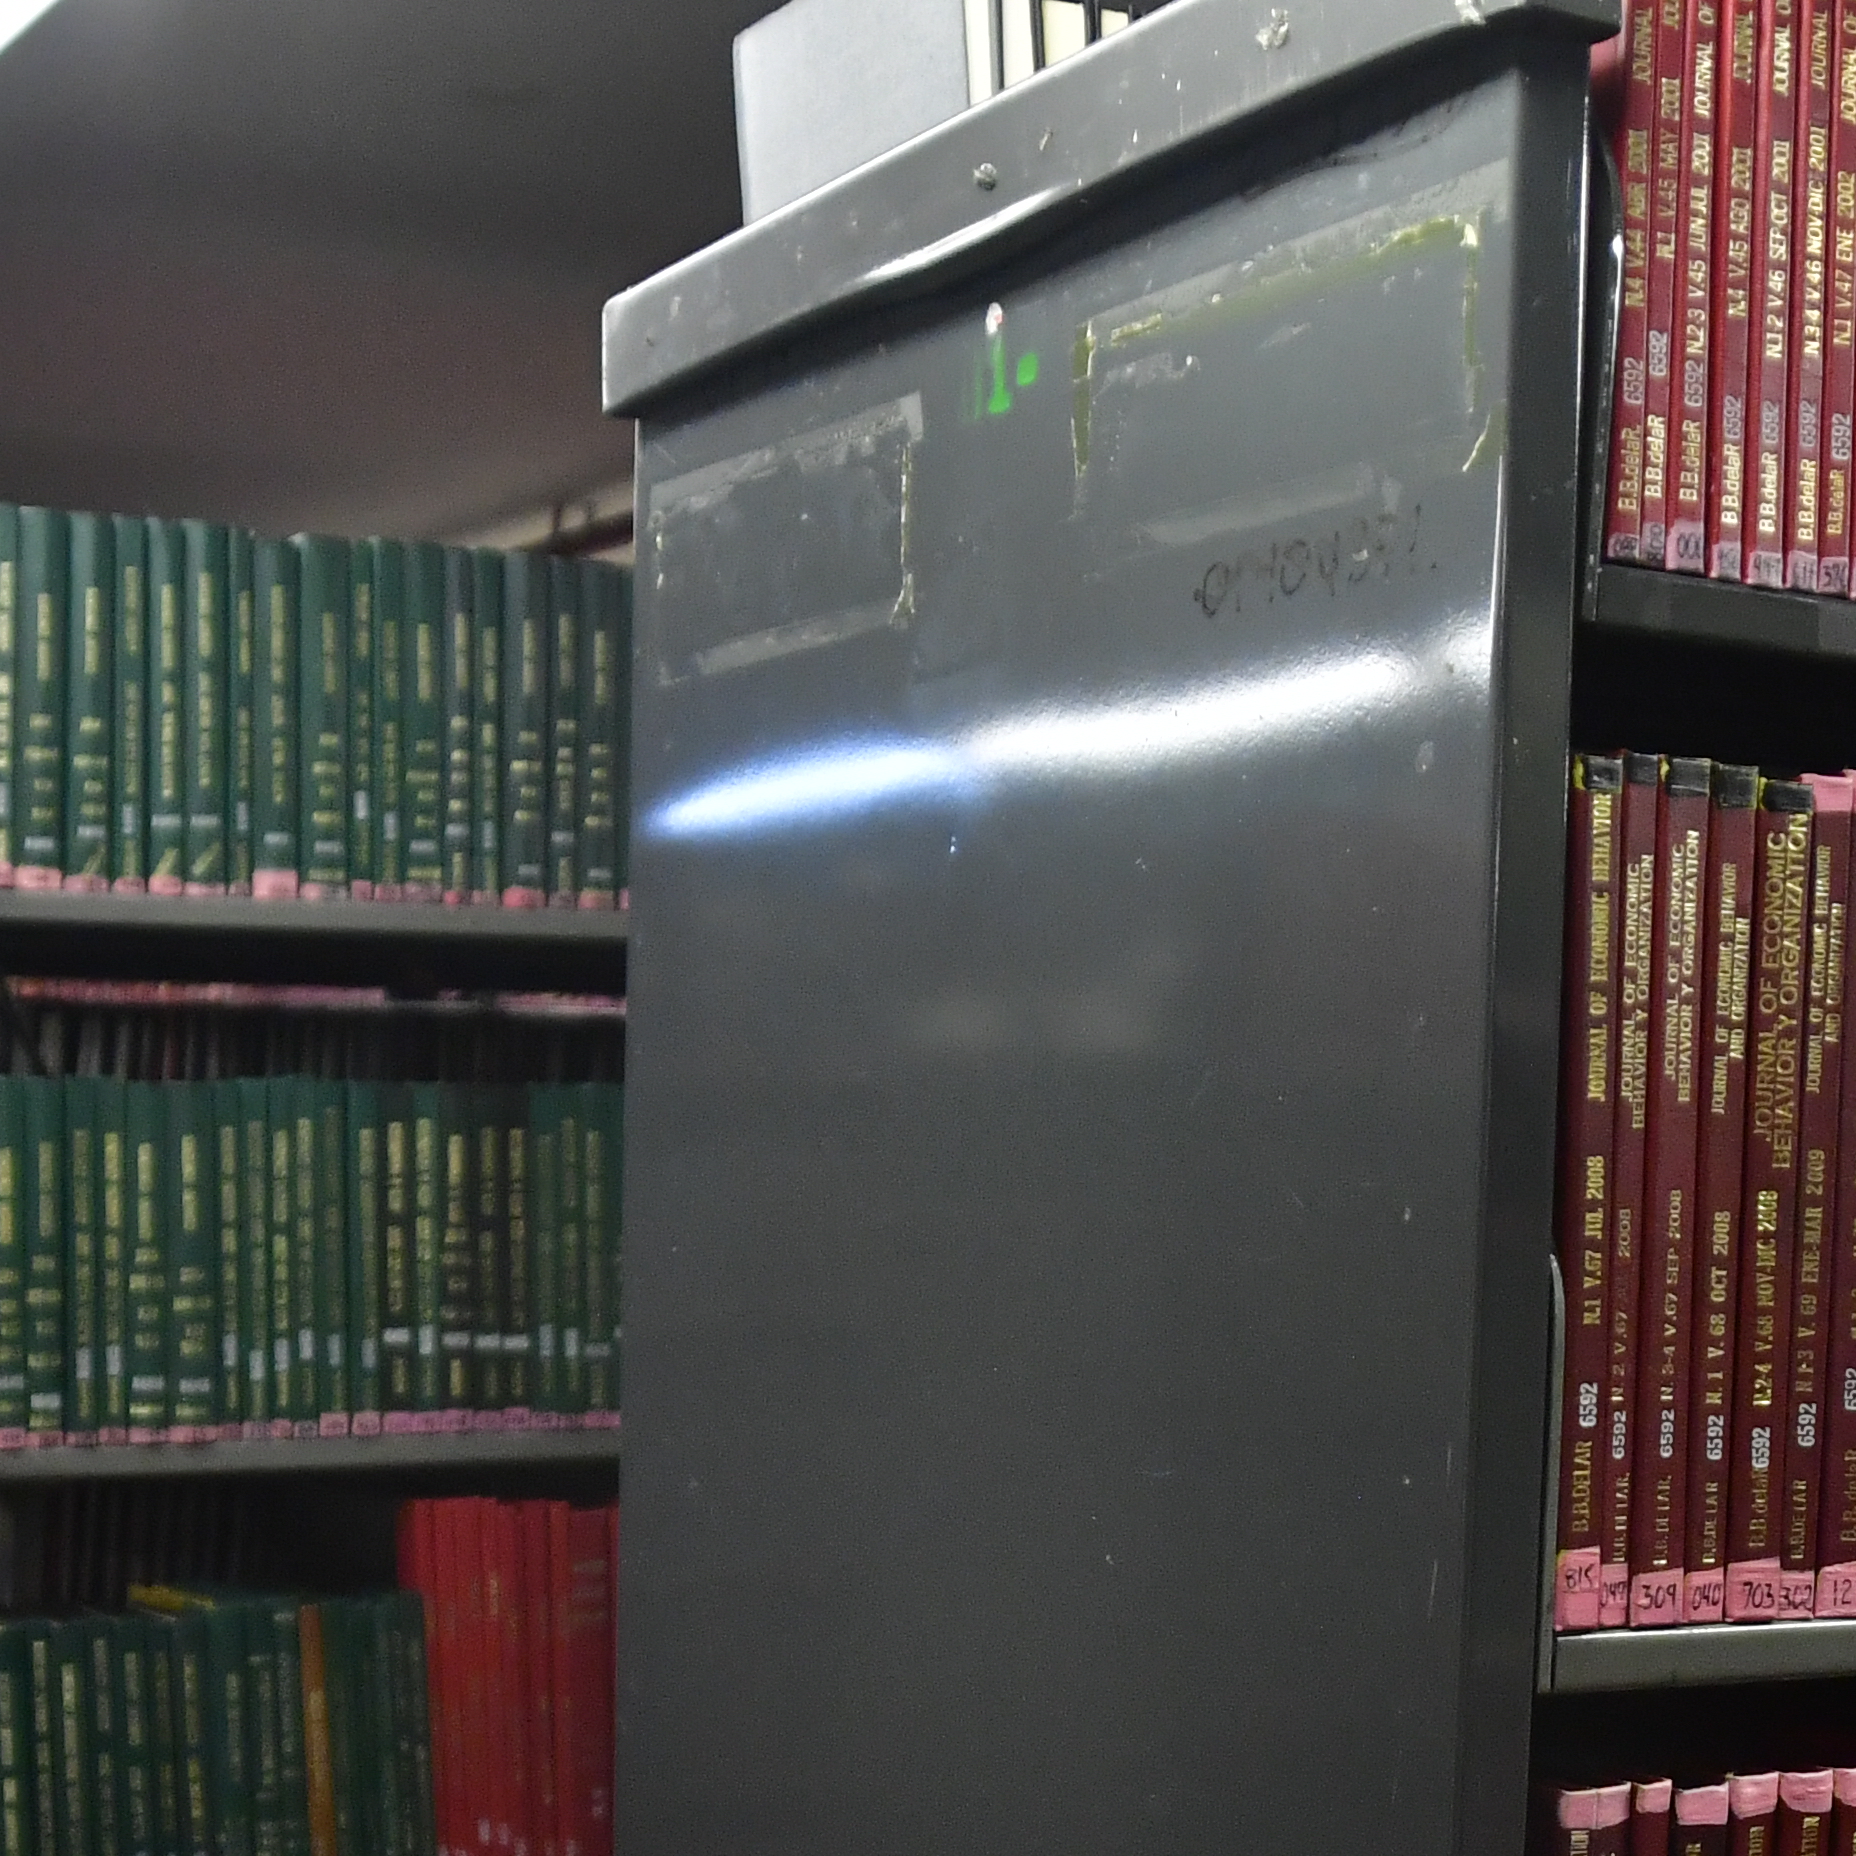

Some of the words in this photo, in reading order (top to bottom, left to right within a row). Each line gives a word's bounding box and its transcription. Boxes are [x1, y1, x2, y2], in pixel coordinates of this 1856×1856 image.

[1811, 10, 1828, 89] JOURNAL
[1809, 125, 1825, 171] 2001
[1805, 261, 1821, 300] V.46
[1800, 400, 1816, 448] 6592
[1800, 459, 1816, 540] B.B.delaR
[1592, 794, 1612, 881] BEHAVIOR
[1719, 863, 1737, 932] BEHAVIOR
[1762, 832, 1786, 968] ECONOMIC
[1780, 813, 1808, 1005] ORGANIZATION
[1590, 892, 1610, 981] ECONOMIC
[1716, 942, 1733, 1015] ECONOMIC
[1732, 917, 1750, 1020] ORGANIZATION
[1590, 991, 1608, 1015] OF
[1760, 978, 1777, 1014] OF
[1715, 1025, 1729, 1043] OF
[1730, 1029, 1744, 1059] AND
[1779, 1015, 1797, 1028] Y
[1588, 1024, 1607, 1101] JOURNAL
[1711, 1055, 1728, 1114] JOURNAL
[1754, 1023, 1777, 1142] JOURNAL
[1774, 1039, 1796, 1169] BEHAVIOR
[1587, 1156, 1605, 1199] 2008
[1586, 1209, 1603, 1240] JUL
[1713, 1211, 1731, 1255] 2008
[1758, 1191, 1778, 1231] 2008
[1584, 1251, 1602, 1288] V.67
[1709, 1267, 1728, 1301] OCT
[1580, 1382, 1598, 1427] 6592
[1707, 1415, 1725, 1460] 6592
[1752, 1427, 1770, 1468] 6592
[1640, 1585, 1679, 1609] 309
[1745, 1582, 1773, 1609] 703
